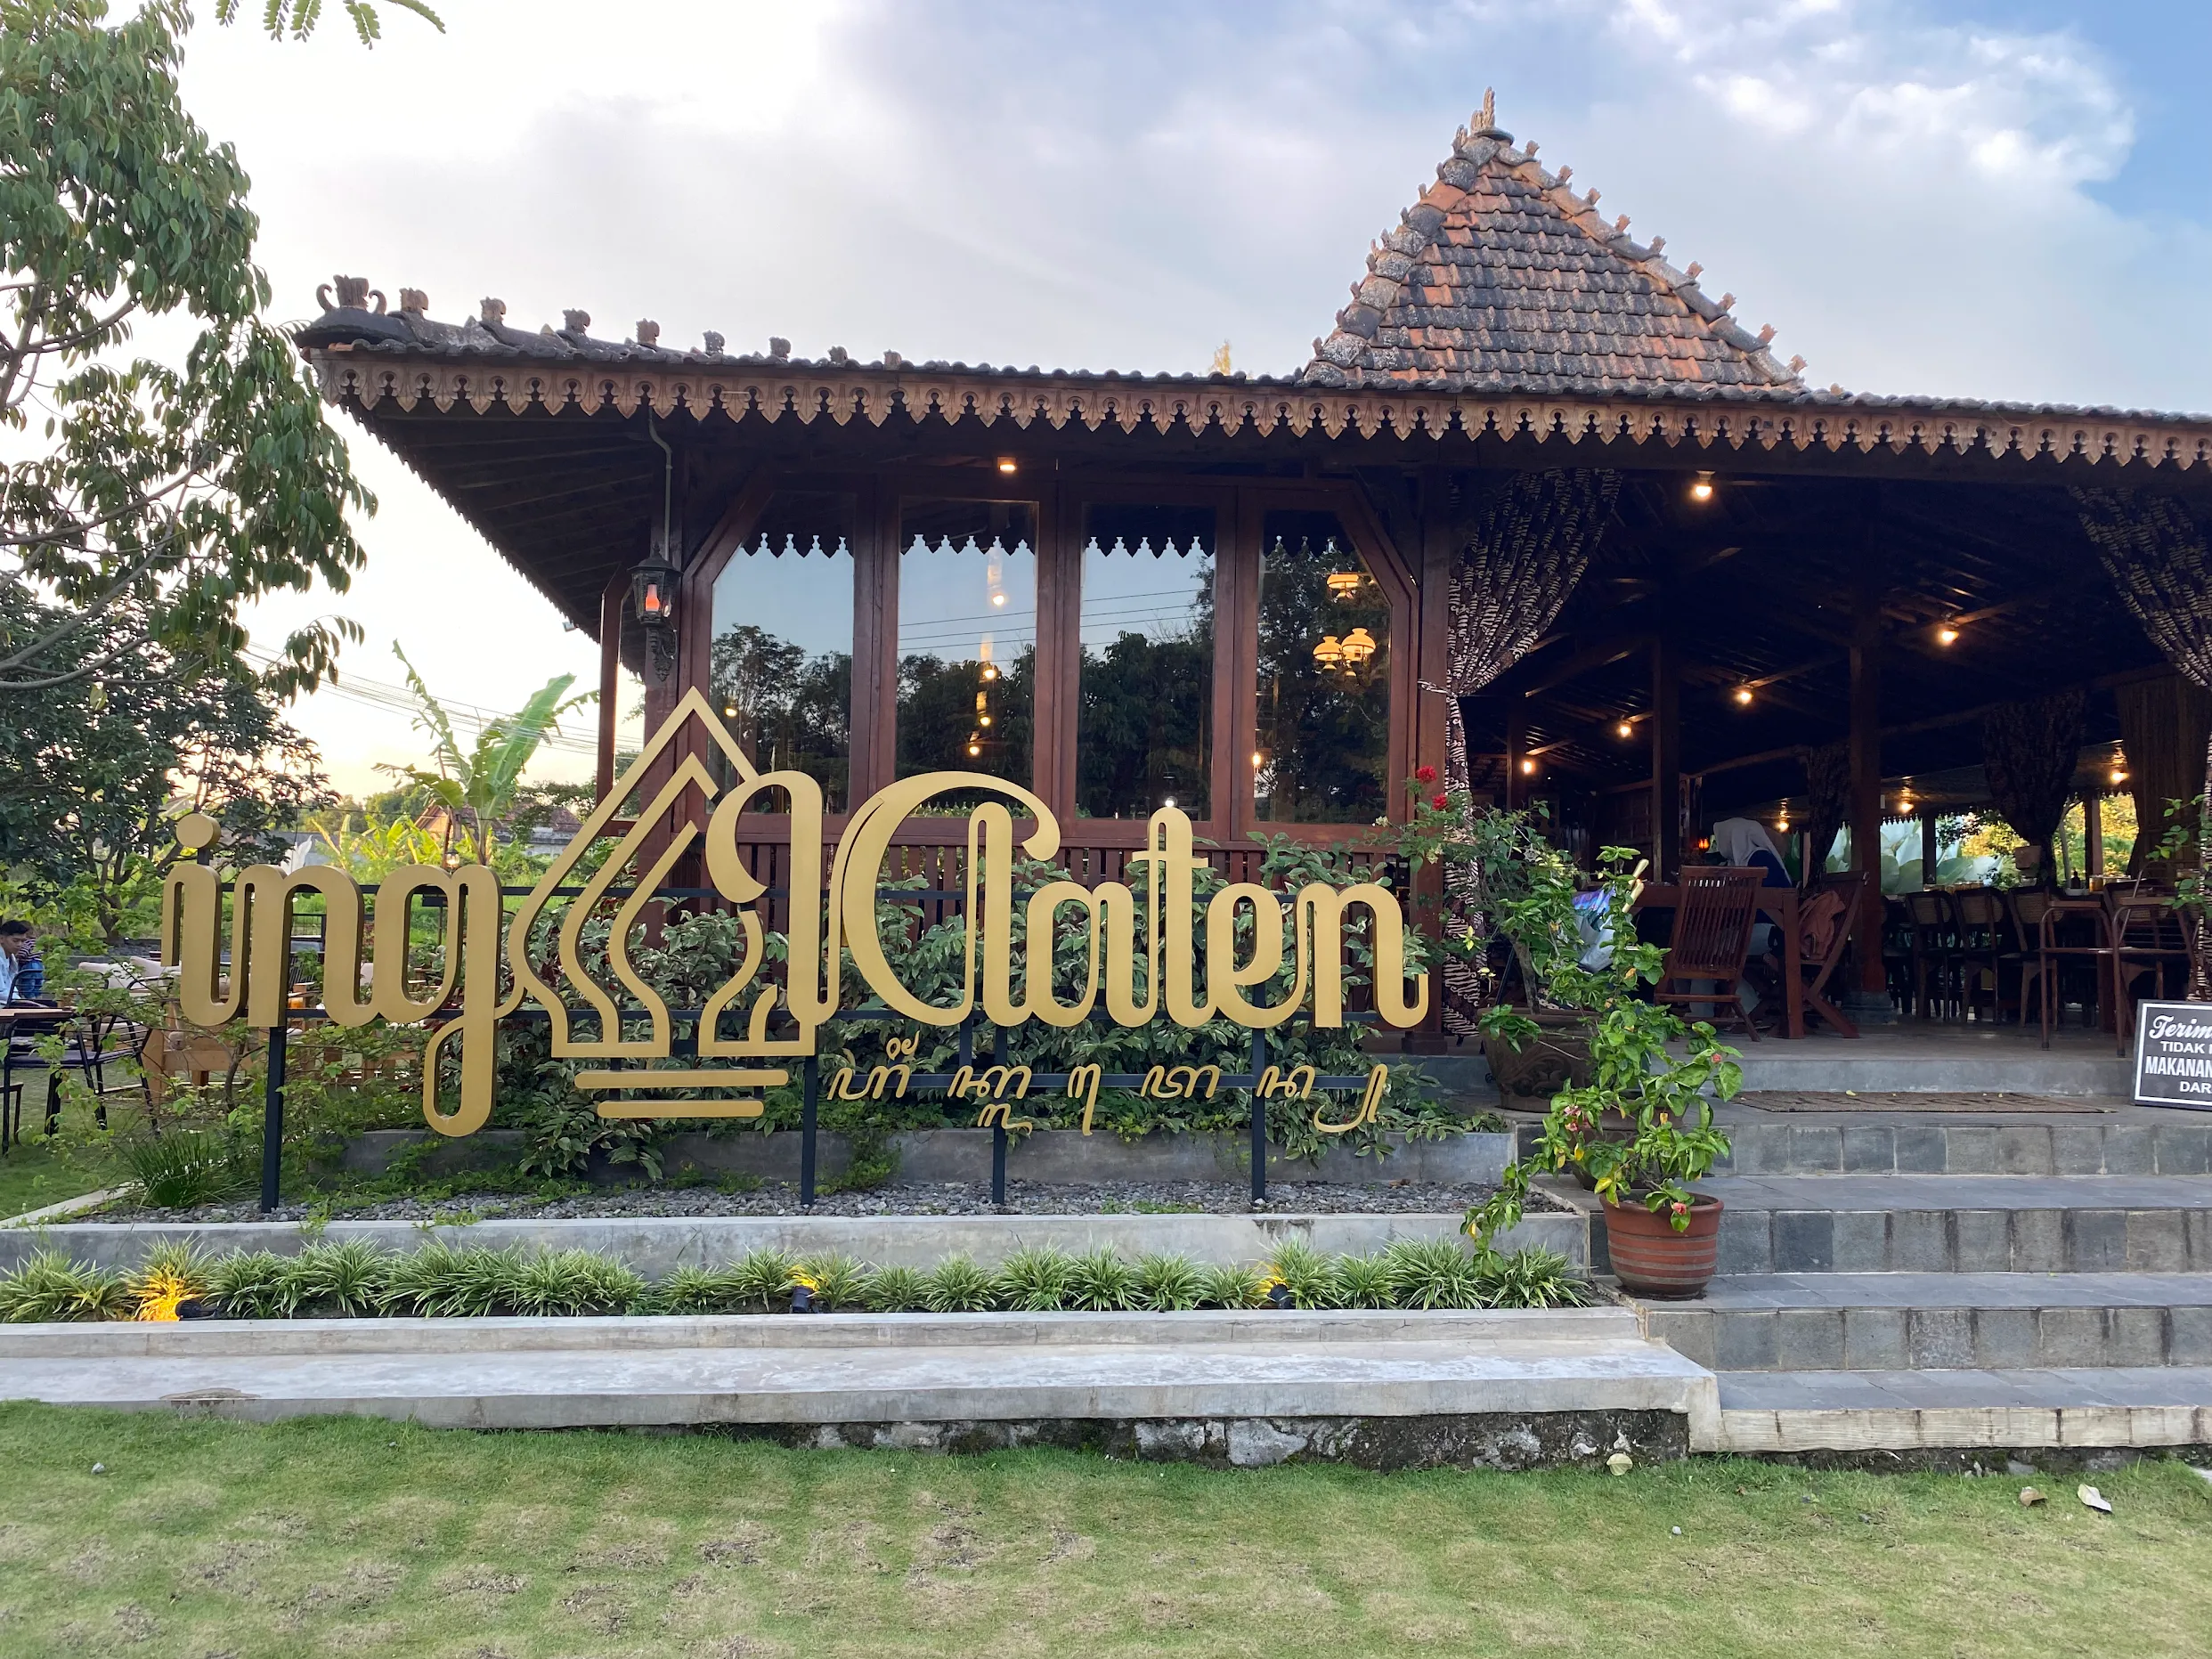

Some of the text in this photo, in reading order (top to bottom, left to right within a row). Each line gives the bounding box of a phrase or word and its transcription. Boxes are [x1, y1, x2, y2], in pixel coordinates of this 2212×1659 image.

[161, 814, 525, 1136] ing
[2159, 1040, 2206, 1054] TIDAK
[2144, 1055, 2212, 1078] MAKANAN
[2179, 1080, 2212, 1094] DAR
